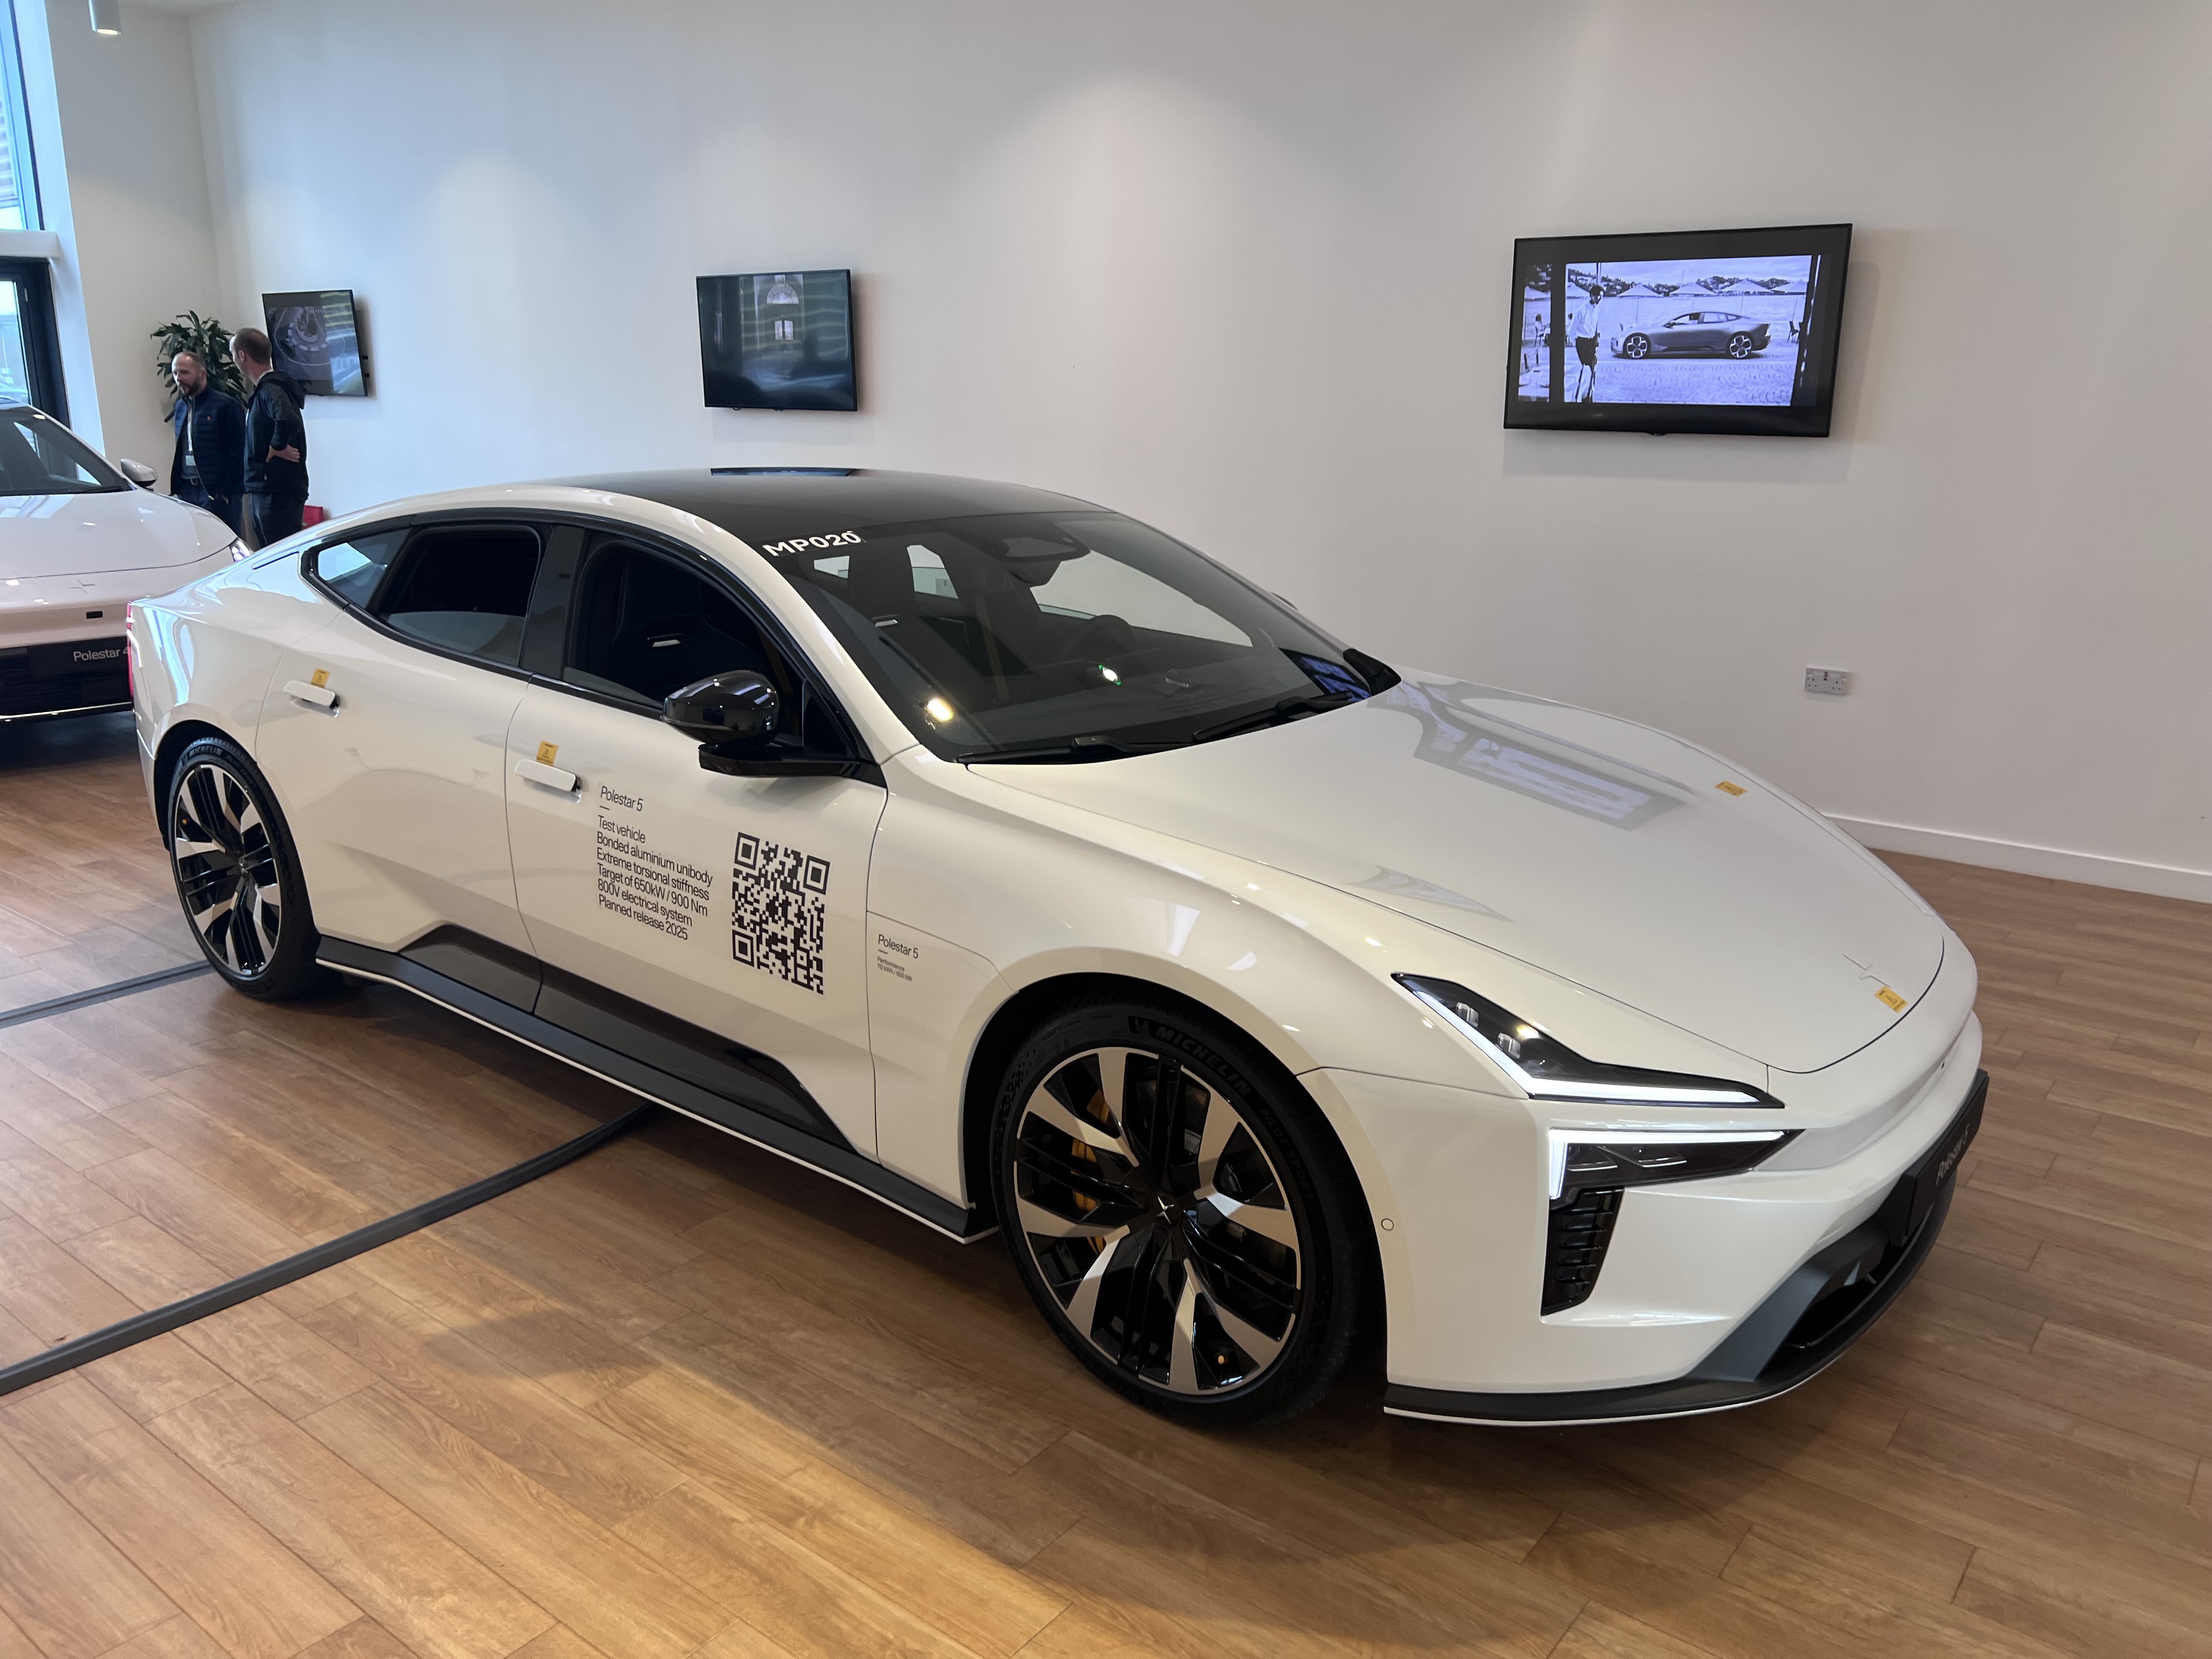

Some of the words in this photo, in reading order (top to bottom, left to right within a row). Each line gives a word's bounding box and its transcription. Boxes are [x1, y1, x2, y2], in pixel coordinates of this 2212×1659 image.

[762, 531, 862, 556] MP020
[74, 648, 120, 662] Polestar
[601, 786, 635, 809] Polestar
[636, 799, 643, 811] 5
[598, 815, 614, 833] Test
[617, 824, 646, 843] vehicle
[597, 831, 629, 854] Bonded
[631, 845, 675, 871] aluminium
[677, 864, 713, 888] unibody
[597, 848, 631, 871] Extreme
[634, 863, 669, 885] torsional
[672, 877, 709, 901] stiffness
[597, 862, 623, 883] Target
[625, 876, 633, 887] of
[635, 879, 664, 900] 650kW
[667, 890, 670, 901] /
[672, 893, 689, 909] 900
[691, 899, 708, 917] Nm
[598, 879, 619, 897] 800V
[622, 890, 658, 913] electrical
[661, 905, 692, 927] system
[599, 894, 631, 917] Planned
[634, 909, 664, 930] release
[666, 921, 687, 940] 2025
[878, 934, 911, 956] Polestar
[913, 947, 918, 959] 5
[1155, 1026, 1253, 1096] MICHELIN
